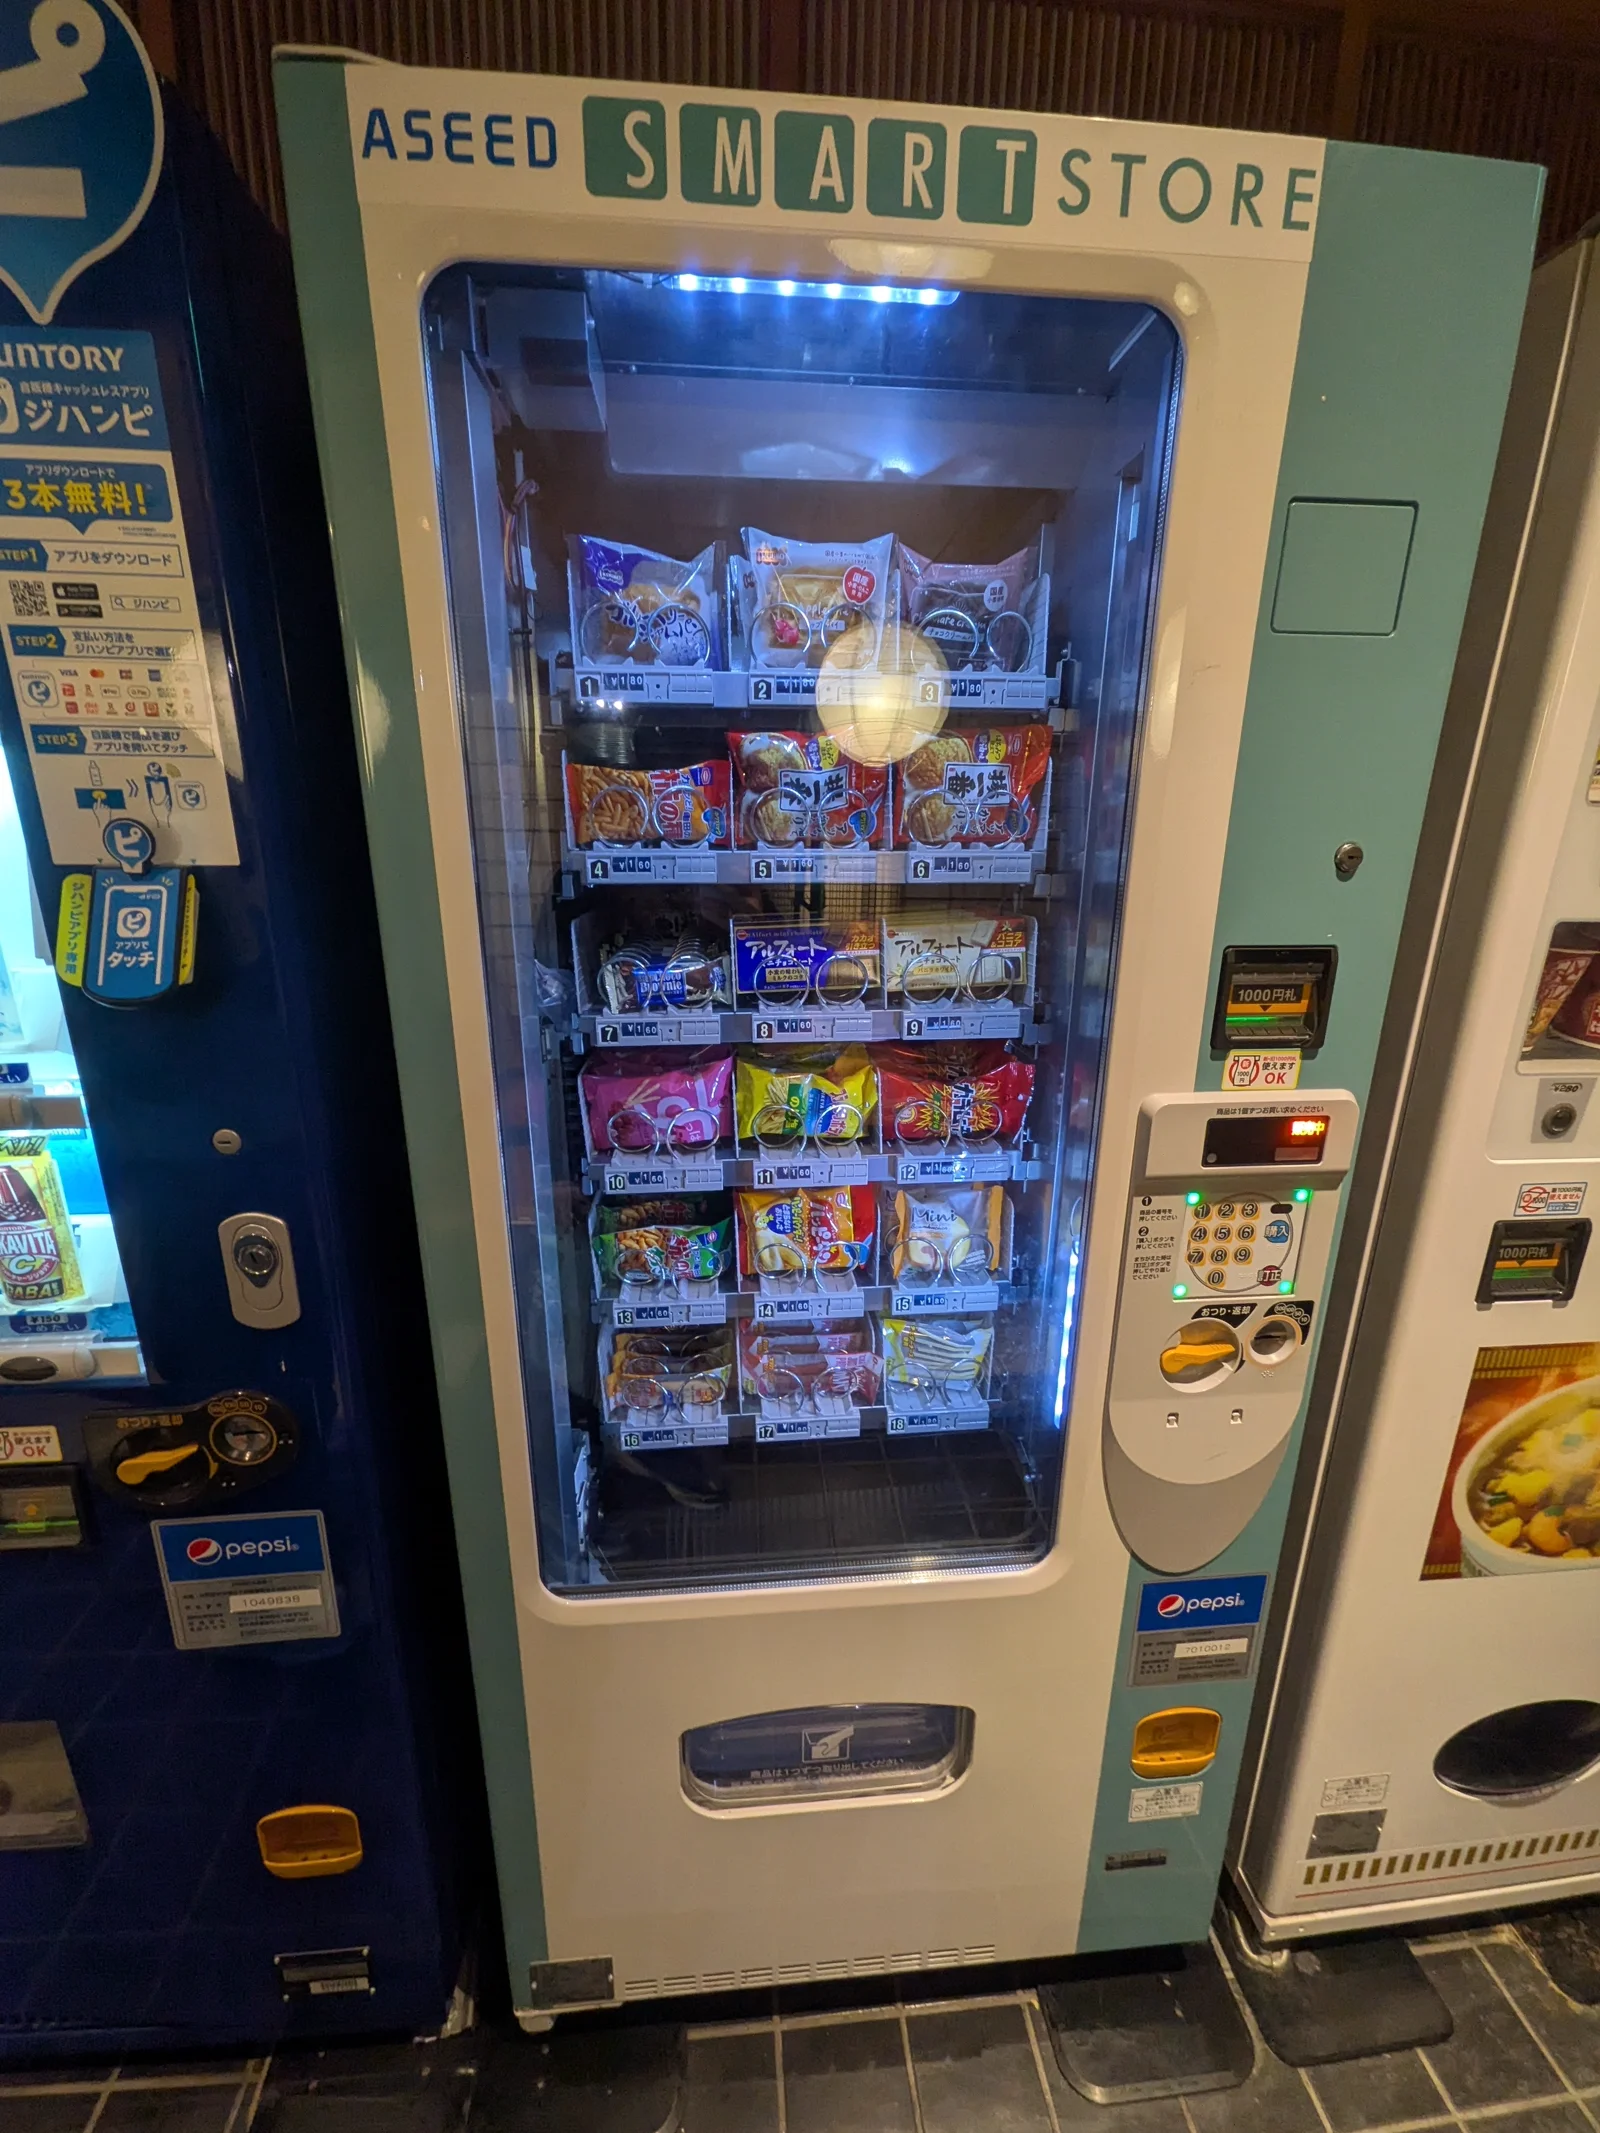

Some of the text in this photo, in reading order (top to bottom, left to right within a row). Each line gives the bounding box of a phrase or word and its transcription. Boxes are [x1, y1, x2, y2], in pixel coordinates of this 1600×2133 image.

[362, 107, 1317, 231] ASEED SMART STORE
[0, 342, 124, 372] UNTORY
[23, 399, 153, 437] ジハンピ
[25, 463, 116, 479] アプリダウンロードで
[54, 549, 173, 567] アプリをダウンロード
[133, 598, 170, 610] ジハンピ
[15, 634, 58, 649] STEP2
[72, 631, 135, 644] 支払い方法を
[59, 669, 79, 677] VISA
[584, 679, 593, 697] 1
[757, 681, 768, 699] 2
[925, 687, 934, 701] 3
[37, 734, 78, 747] STEP3
[93, 742, 188, 754] アプリを開いてタッチ
[593, 863, 603, 878] 4
[758, 862, 767, 877] 5
[917, 862, 925, 877] 6
[115, 939, 149, 950] アプリで
[745, 937, 828, 959] アルフォート
[894, 935, 975, 958] アルフォート
[107, 951, 155, 969] タッチ
[1238, 988, 1297, 1002] 1000円札
[604, 1026, 613, 1041] 7
[760, 1024, 769, 1039] 8
[910, 1021, 918, 1035] 9
[1262, 1061, 1296, 1071] 使えます
[1264, 1072, 1287, 1085] OK
[757, 1171, 771, 1184] 11
[901, 1166, 915, 1180] 12
[609, 1176, 624, 1190] 10
[911, 1206, 958, 1223] Mini
[1499, 1246, 1549, 1259] 1000円札
[759, 1304, 773, 1318] 14
[896, 1298, 910, 1311] 15
[1201, 1305, 1251, 1316] おつり・返却
[618, 1311, 633, 1324] 13
[891, 1418, 905, 1431] 18
[759, 1426, 773, 1439] 17
[625, 1434, 640, 1447] 16
[22, 1445, 49, 1457] OK
[226, 1536, 292, 1560] pepsi
[1186, 1593, 1240, 1613] pepsi
